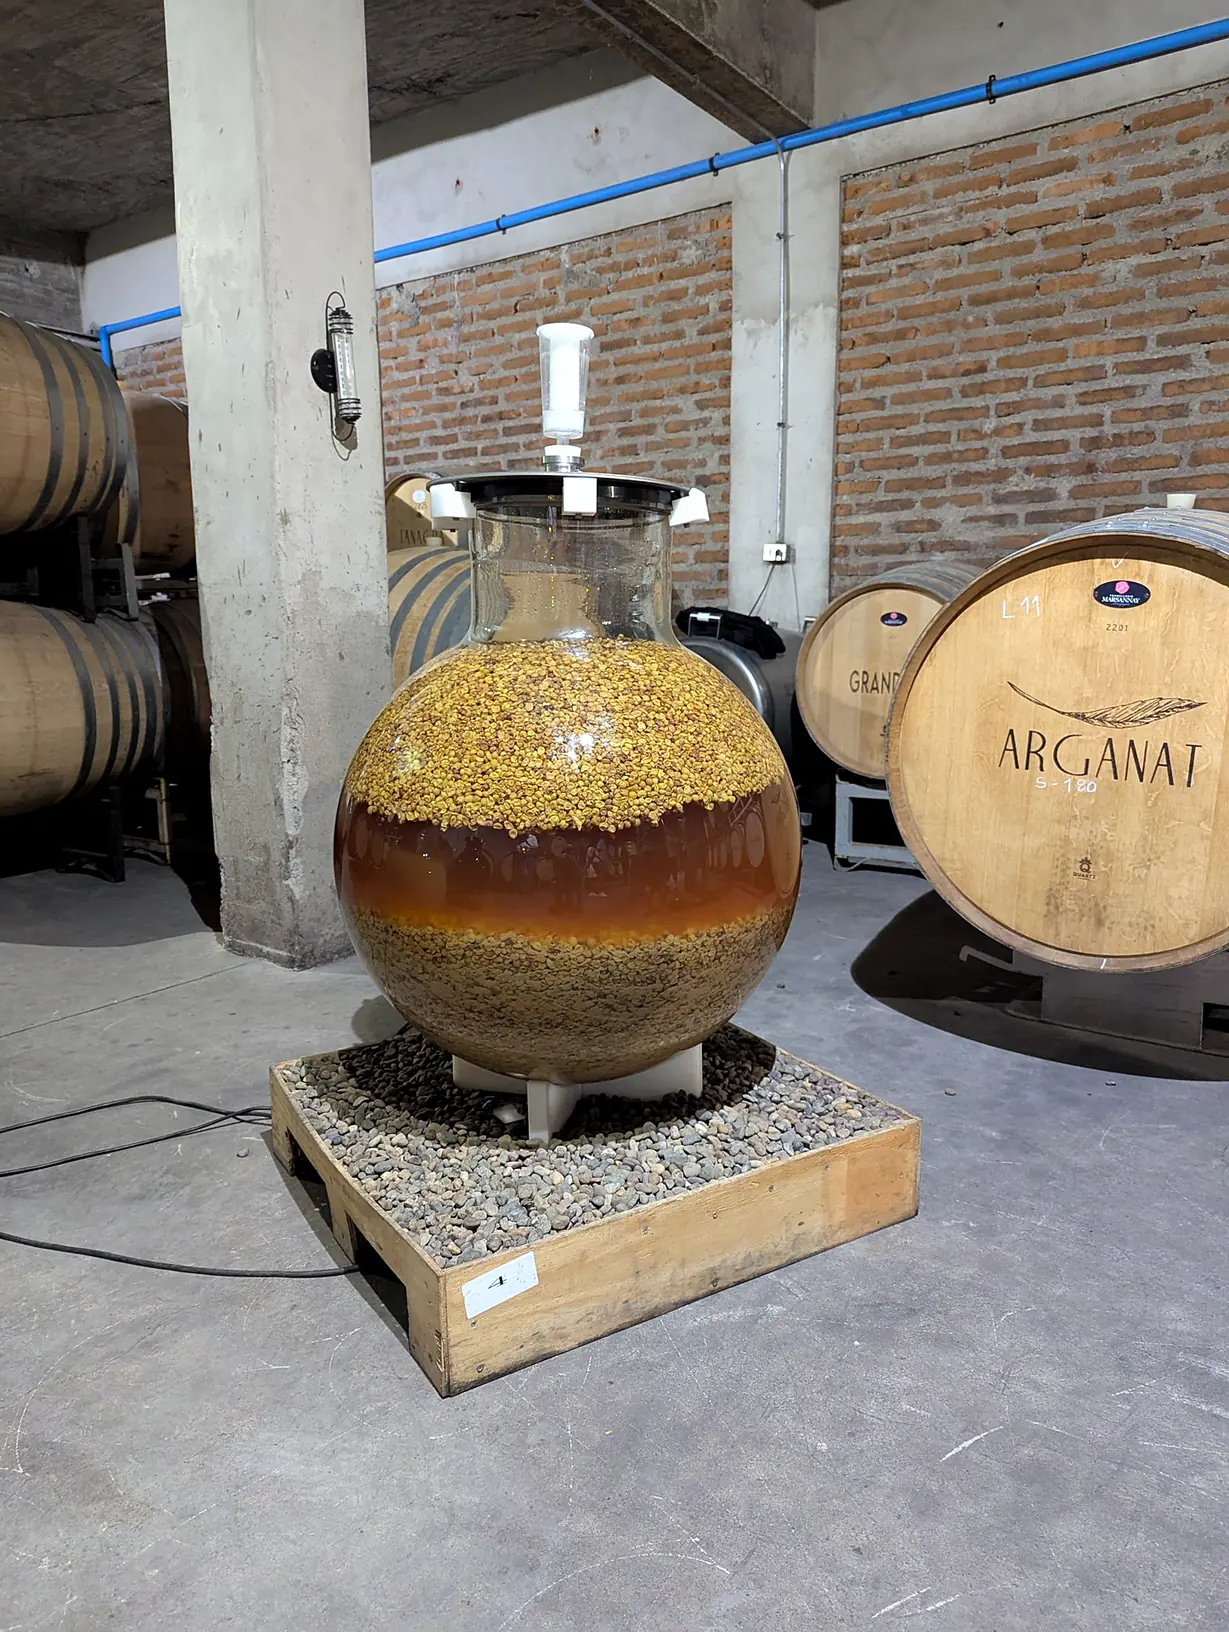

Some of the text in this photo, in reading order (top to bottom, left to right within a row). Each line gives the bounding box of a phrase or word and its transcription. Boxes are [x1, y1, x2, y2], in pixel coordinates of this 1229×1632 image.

[1105, 623, 1129, 632] 2201
[998, 728, 1203, 788] ARGANAT
[487, 1275, 508, 1290] 4
